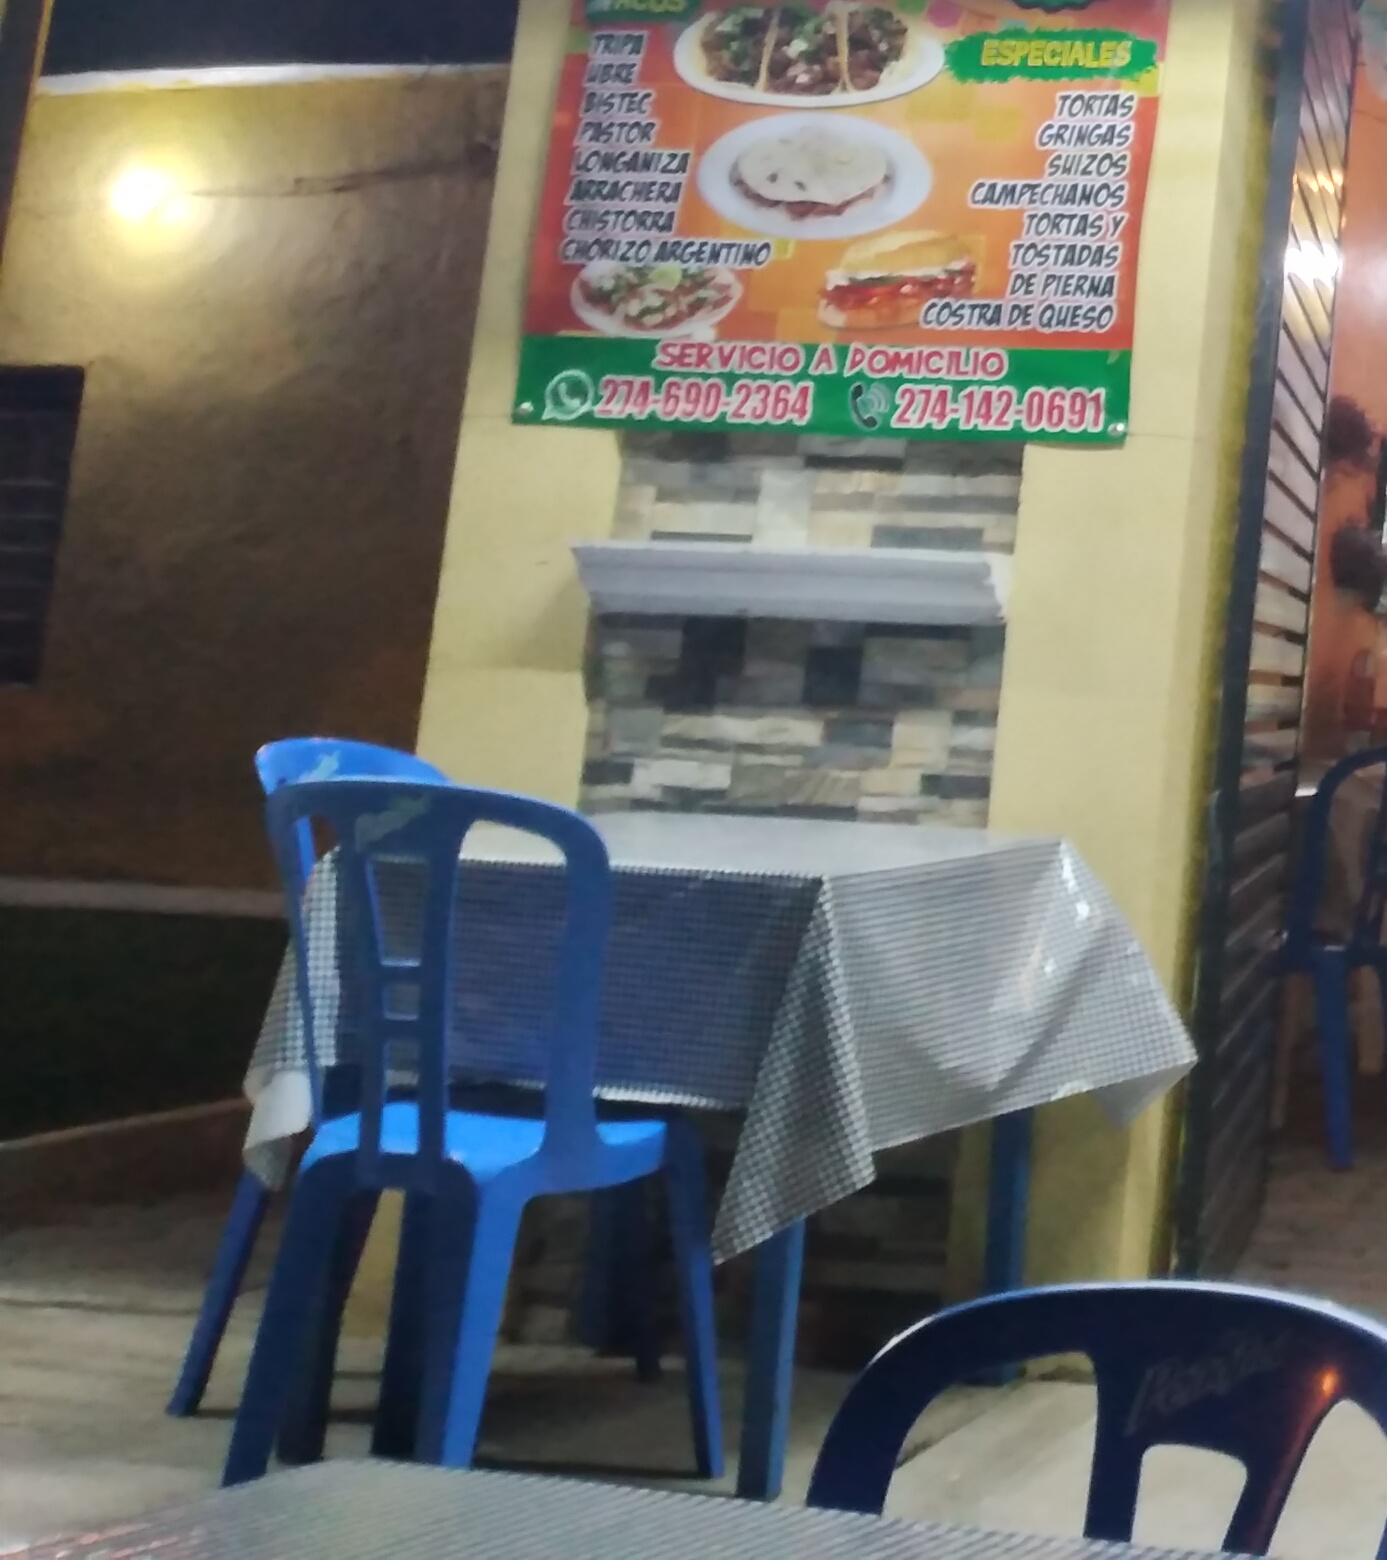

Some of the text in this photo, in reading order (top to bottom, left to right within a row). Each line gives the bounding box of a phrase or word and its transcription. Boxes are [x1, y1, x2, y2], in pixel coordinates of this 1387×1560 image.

[591, 31, 647, 56] TRIPA
[981, 38, 1133, 69] ESPECIALES
[581, 90, 653, 116] BISTEC
[1057, 93, 1136, 119] TORTAS
[577, 119, 657, 145] PASTOR
[1037, 122, 1133, 148] GRINGAS
[573, 148, 692, 175] LONGANIZA
[1047, 151, 1128, 177] SUIZOS
[568, 177, 683, 203] ARRACHERA
[970, 180, 1126, 207] CAMPECHANOS
[564, 207, 677, 233] CHISTORRA
[1023, 211, 1126, 238] TORTAS Y
[561, 237, 772, 267] CHORIZO ARGENTINO
[1010, 241, 1121, 268] TOSTADAS
[1009, 272, 1116, 299] DE PIERNA
[922, 301, 1115, 330] COSTRA DE QUESO
[651, 340, 1009, 381] SERVICIO A DOMICILIO
[597, 374, 815, 427] 274-690-2364
[890, 379, 1107, 433] 274-142-0691
